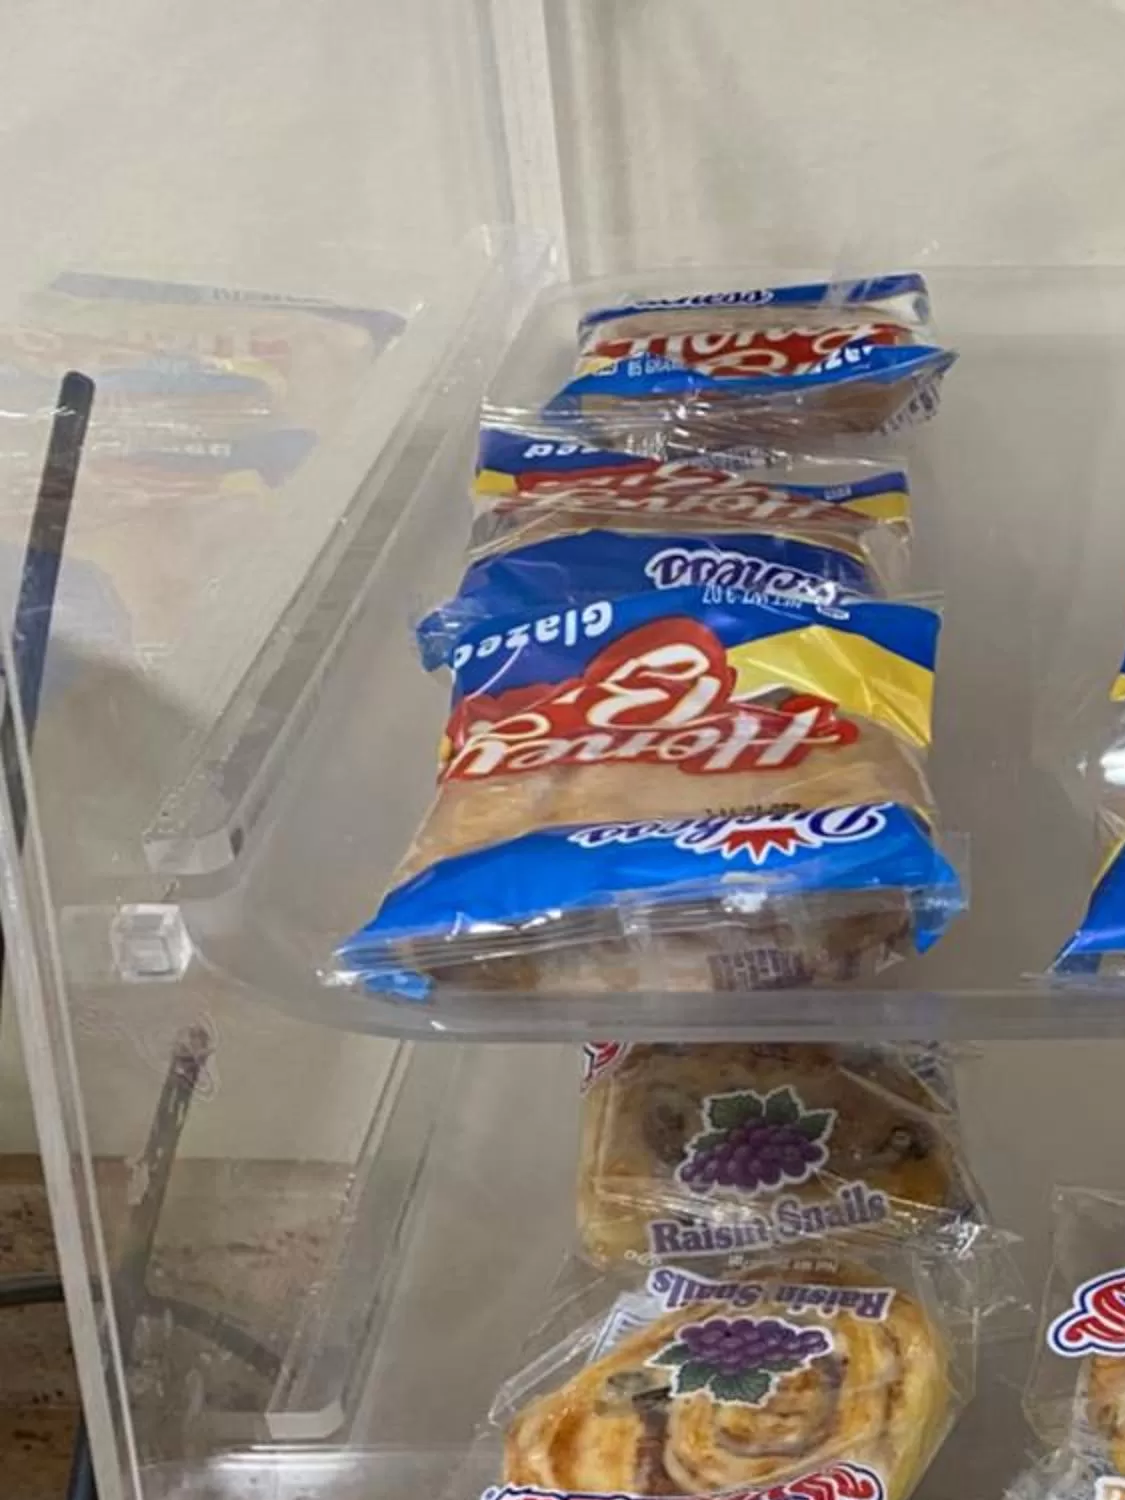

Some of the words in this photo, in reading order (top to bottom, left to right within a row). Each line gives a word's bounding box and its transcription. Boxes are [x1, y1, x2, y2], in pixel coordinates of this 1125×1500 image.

[445, 704, 843, 777] Honey
[651, 1217, 772, 1256] Raisin
[776, 1183, 888, 1241] Snails
[651, 1268, 764, 1310] Snails
[777, 1286, 892, 1319] Raisin
